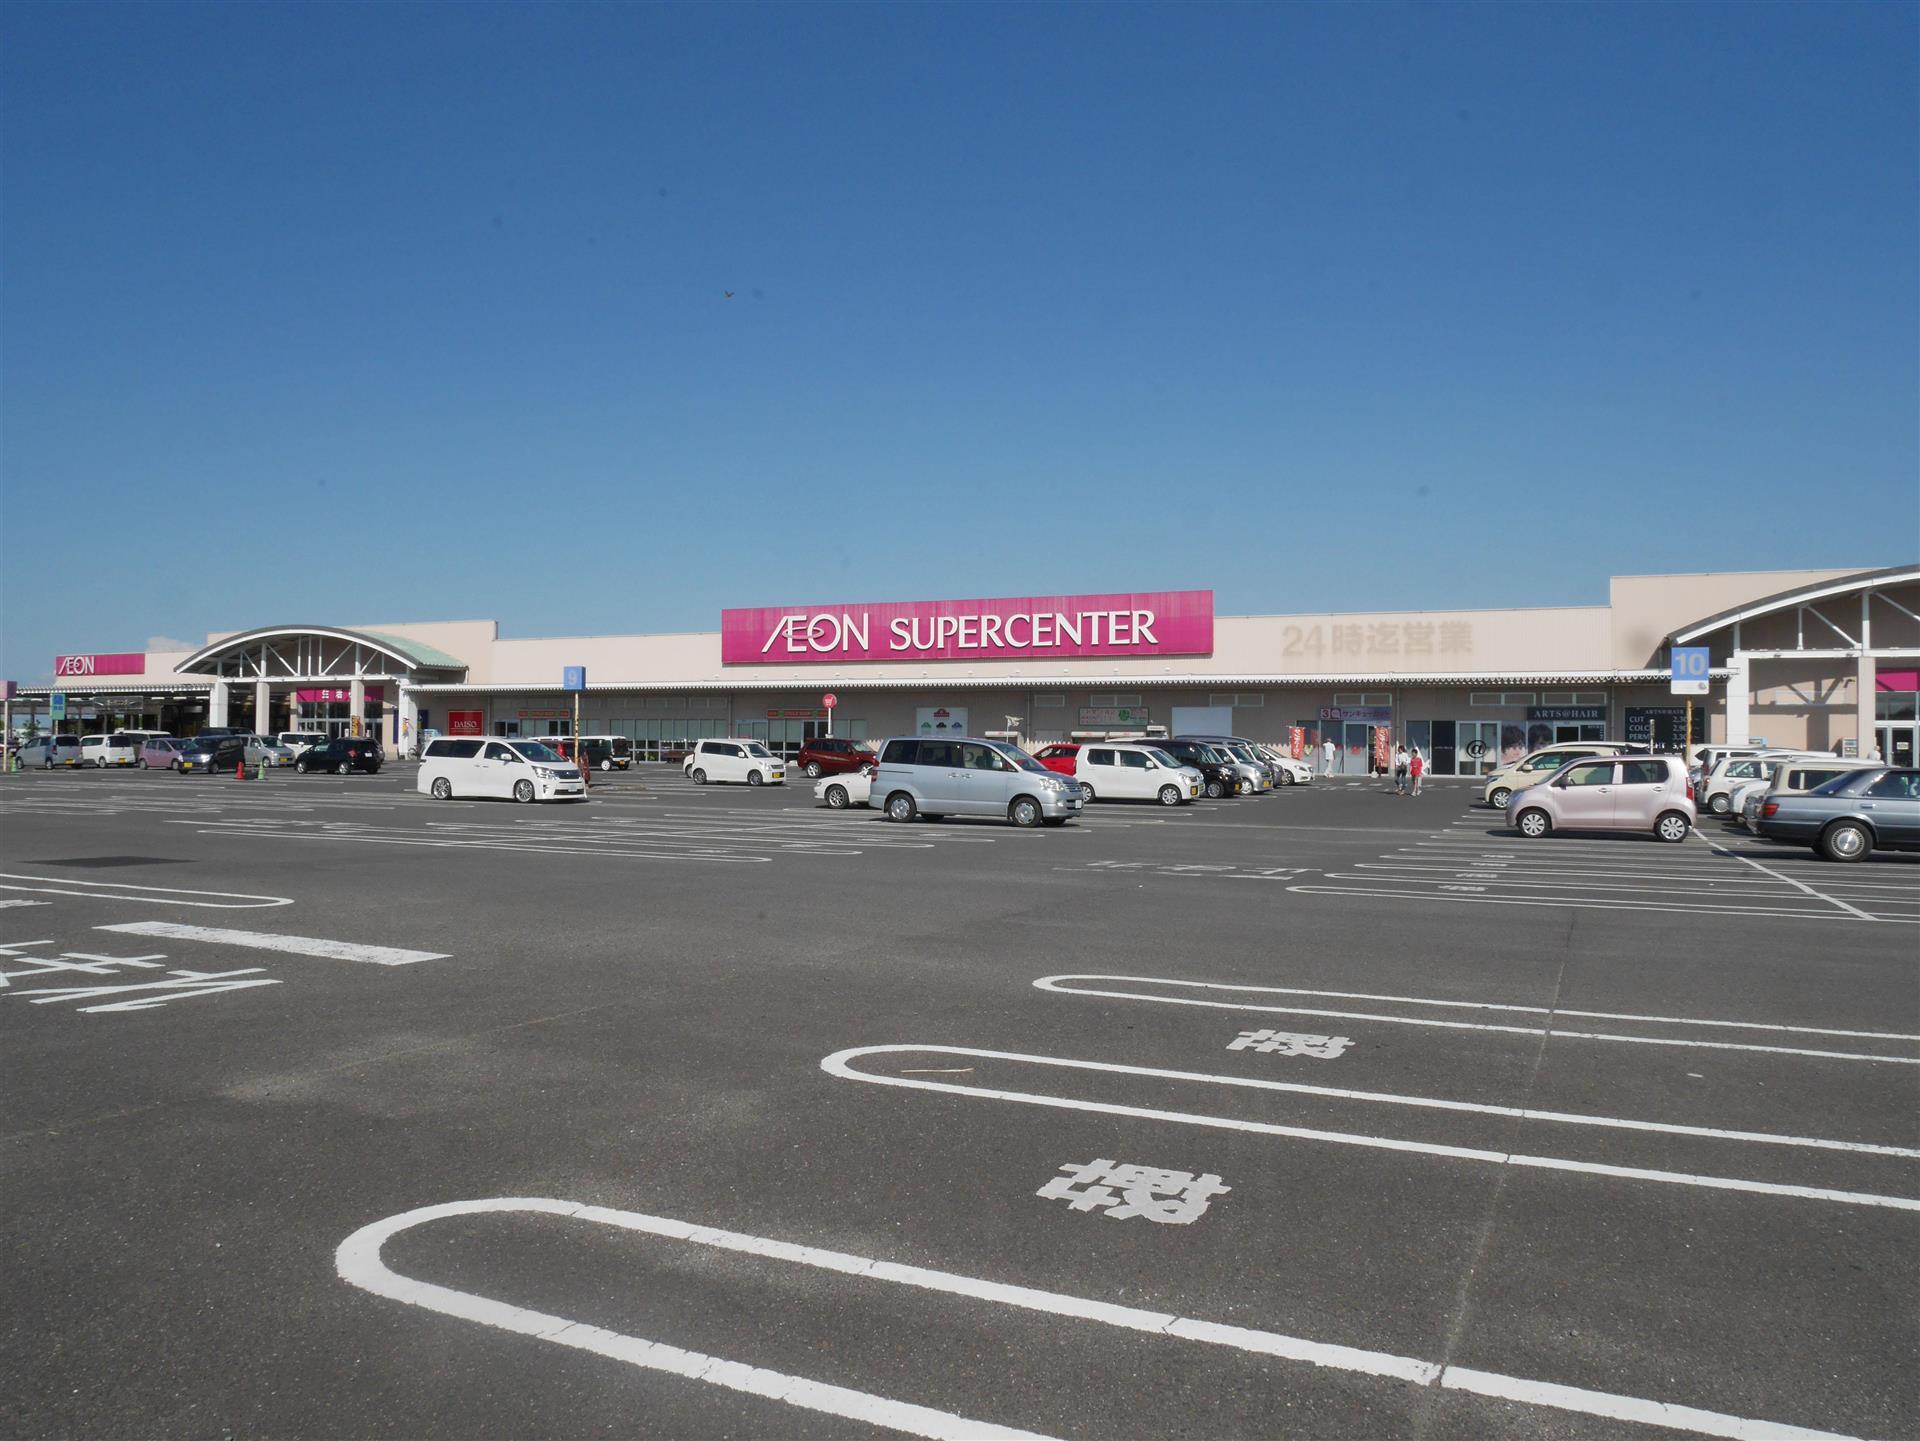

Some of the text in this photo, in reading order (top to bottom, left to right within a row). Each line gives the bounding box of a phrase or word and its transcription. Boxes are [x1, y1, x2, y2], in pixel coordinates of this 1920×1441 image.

[889, 610, 1159, 651] SUPERCENTER
[1675, 653, 1706, 676] 10
[568, 671, 577, 685] 9
[454, 720, 478, 728] DAISO
